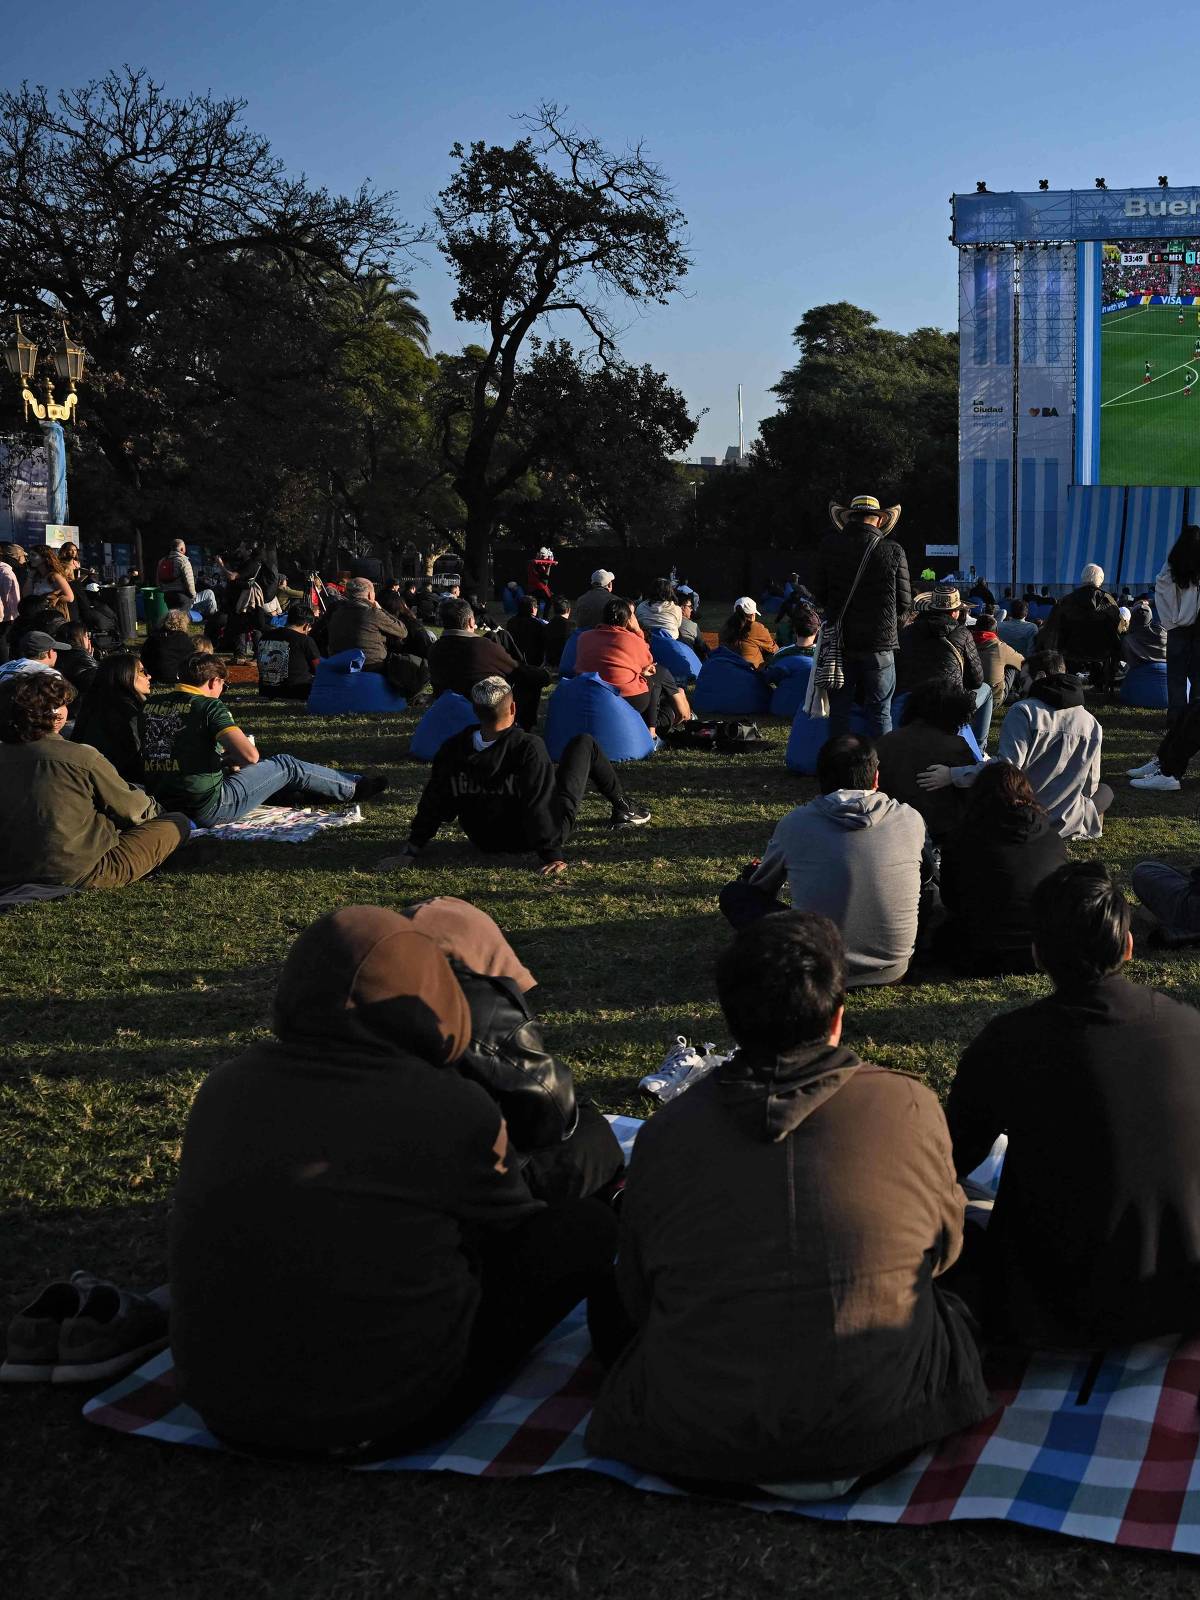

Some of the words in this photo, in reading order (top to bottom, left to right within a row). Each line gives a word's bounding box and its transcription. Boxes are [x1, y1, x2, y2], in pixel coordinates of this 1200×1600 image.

[1123, 255, 1144, 263] 33:49
[1160, 296, 1182, 305] VISA
[1041, 407, 1059, 417] BA
[144, 758, 180, 773] AFRICA
